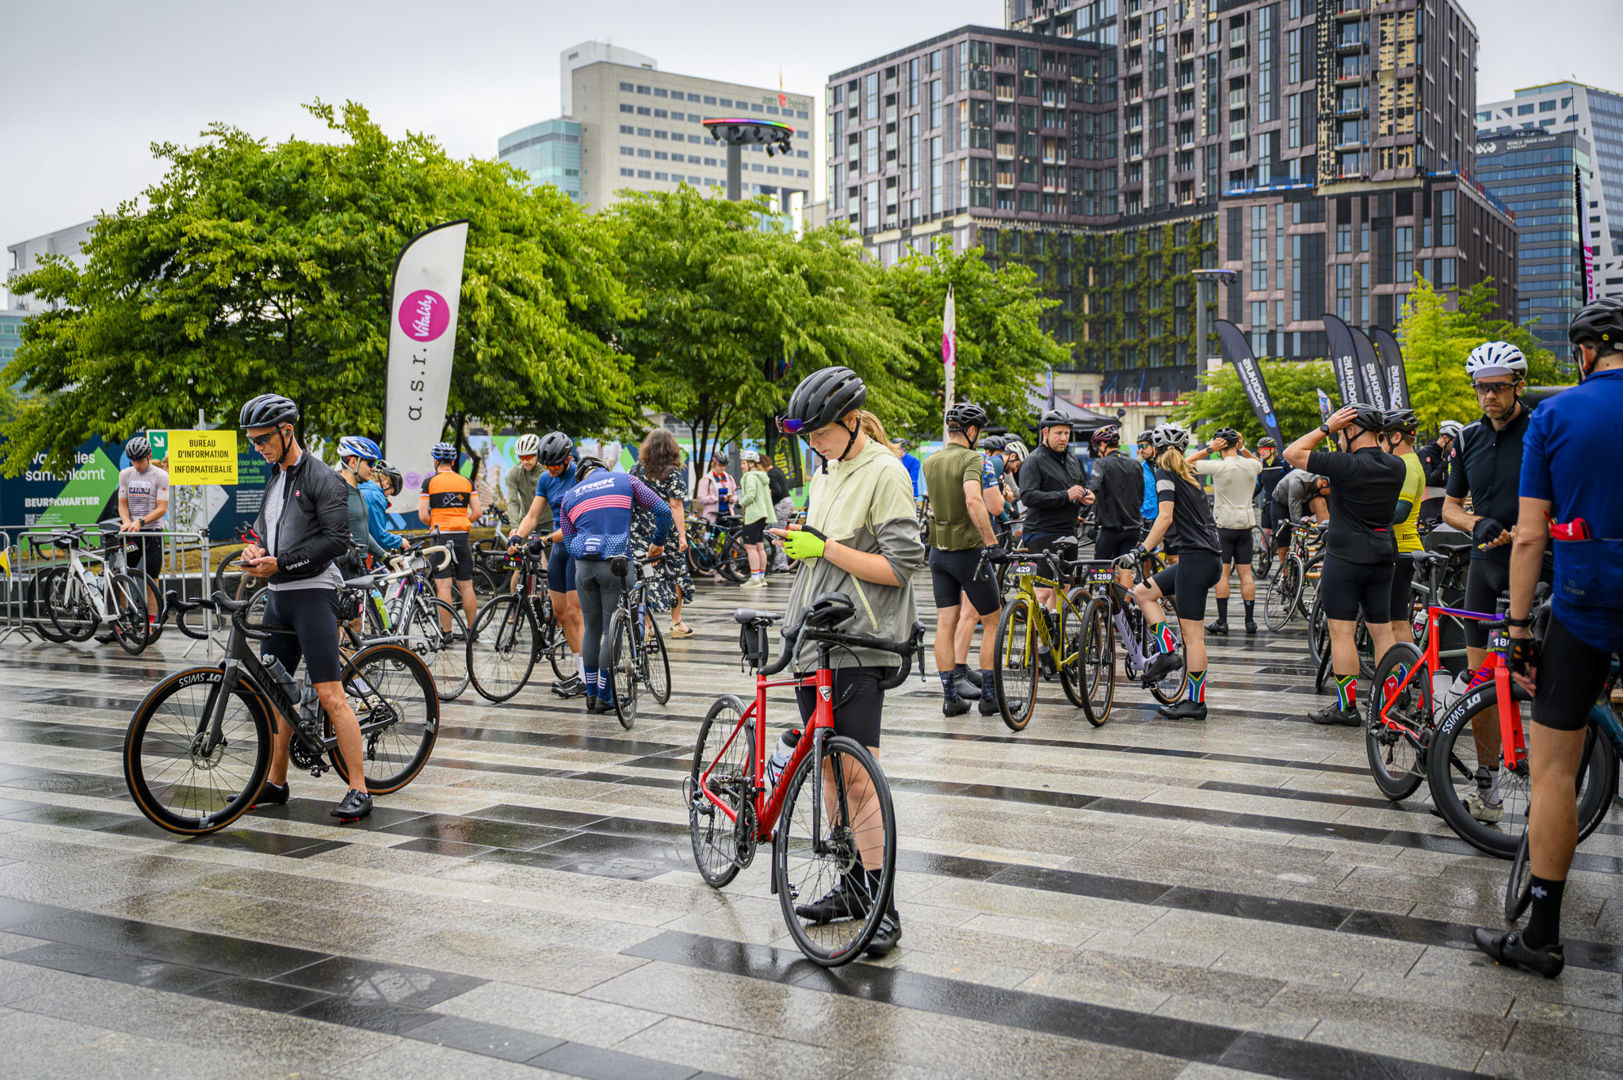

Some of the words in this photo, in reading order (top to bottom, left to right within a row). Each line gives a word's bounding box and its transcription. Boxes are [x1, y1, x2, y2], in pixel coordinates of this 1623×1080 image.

[412, 294, 438, 337] Vitality
[408, 347, 427, 421] a.s.r.
[189, 439, 216, 448] BUREAU
[177, 450, 229, 459] D'INFORMATION
[174, 465, 233, 474] INFORMATIEBALIE
[574, 477, 615, 494] TREK
[24, 496, 100, 508] BEURSKWARTIER
[1092, 573, 1112, 581] 1259
[178, 672, 207, 688] SWISS
[206, 673, 223, 683] DT
[1466, 692, 1482, 710] DT
[1441, 704, 1466, 735] SWISS
